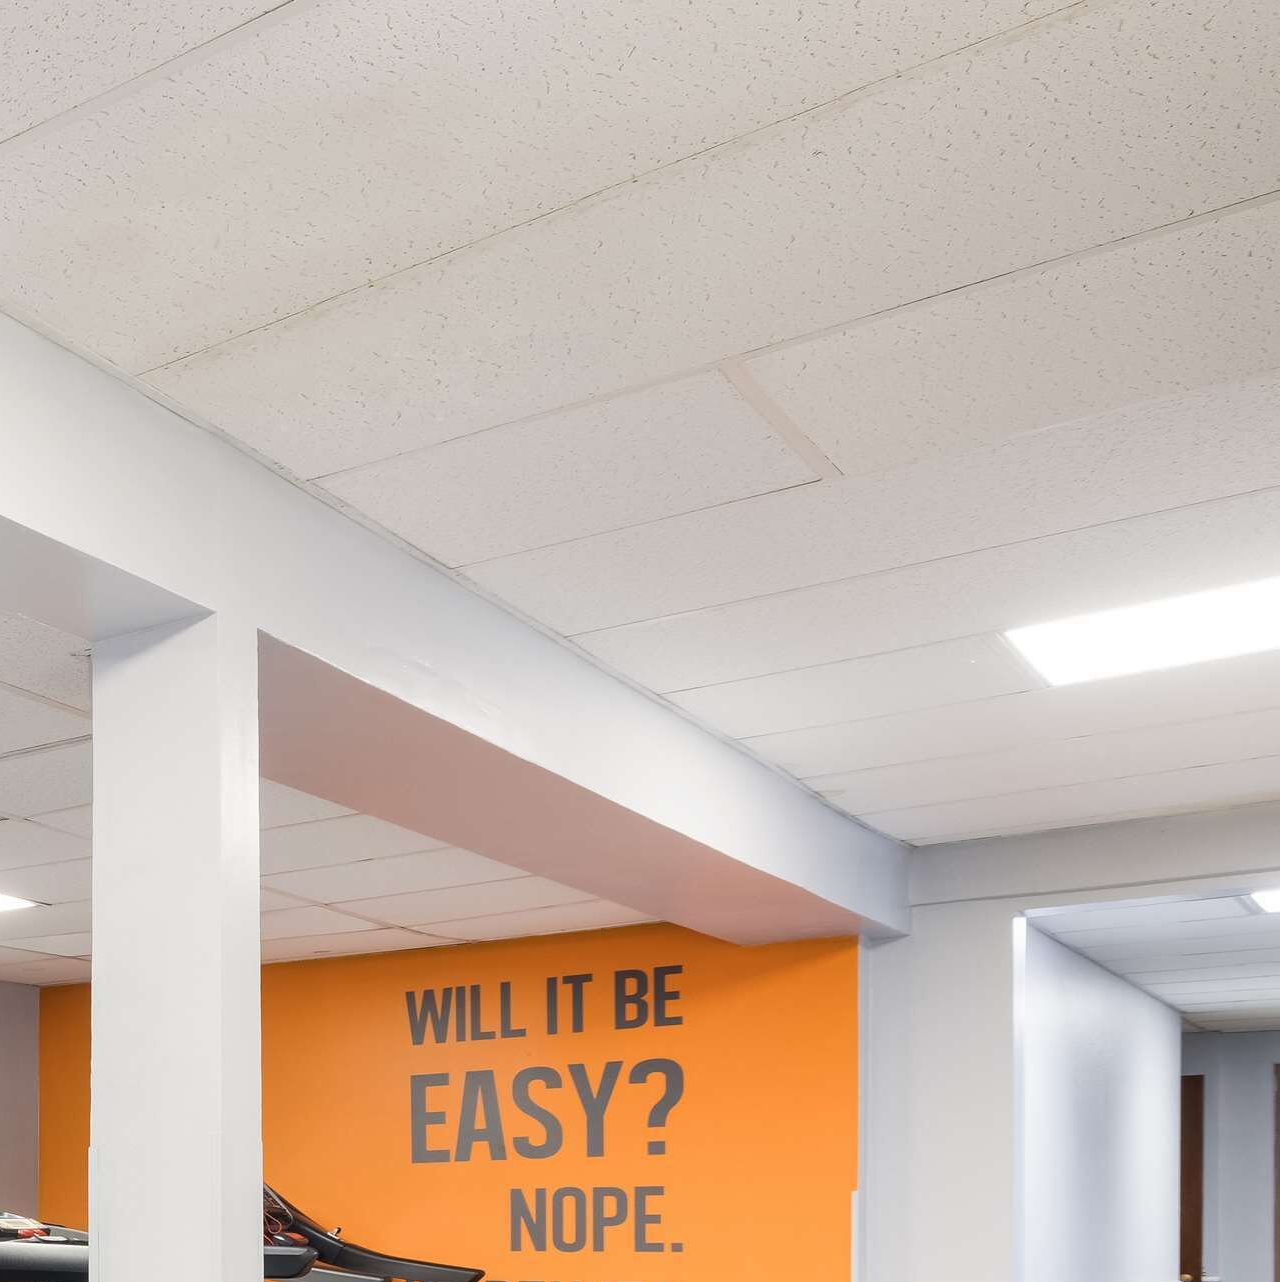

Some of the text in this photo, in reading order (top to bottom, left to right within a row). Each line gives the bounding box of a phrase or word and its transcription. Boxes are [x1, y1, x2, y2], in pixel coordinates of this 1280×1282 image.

[405, 964, 684, 1046] WILL IT BE
[409, 1057, 685, 1165] EASY?
[509, 1185, 685, 1254] NOPE.
